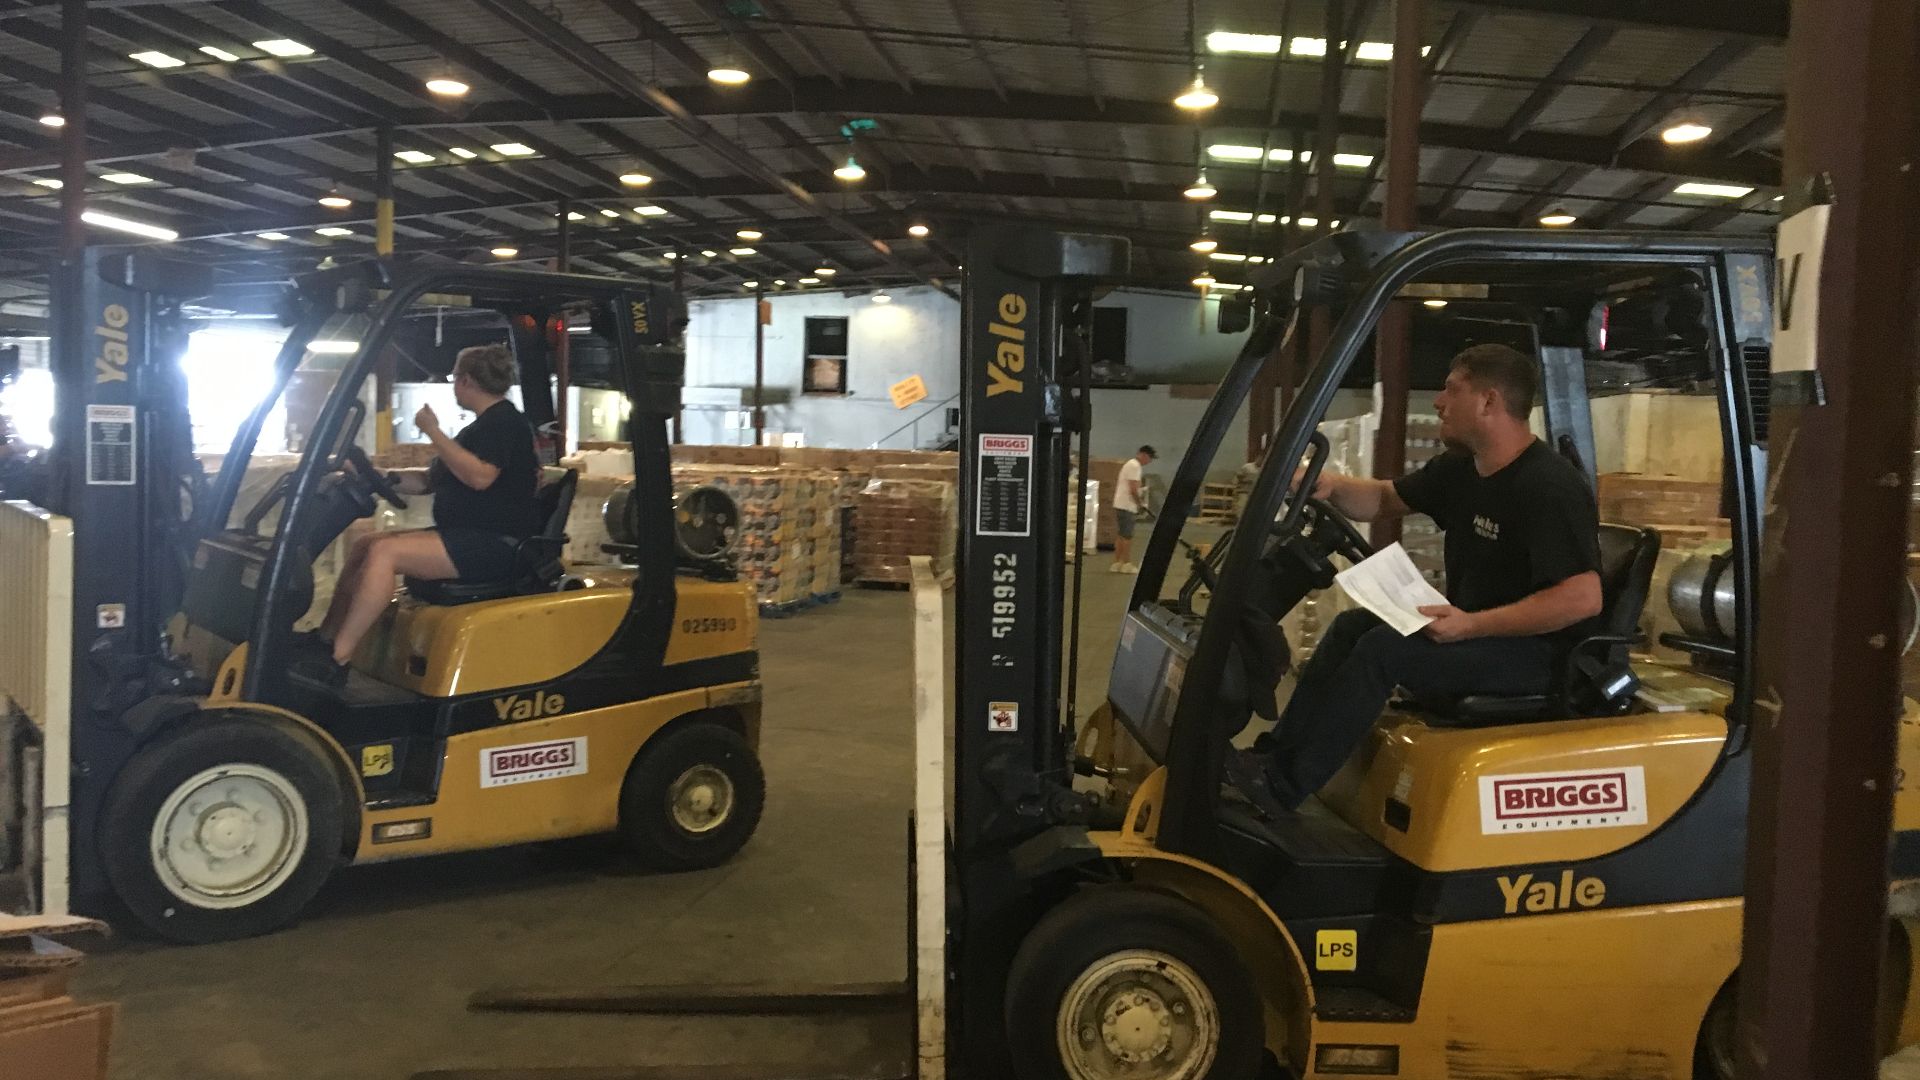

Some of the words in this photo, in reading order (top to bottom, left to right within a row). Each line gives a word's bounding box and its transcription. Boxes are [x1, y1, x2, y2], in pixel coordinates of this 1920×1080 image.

[94, 304, 129, 384] Yale
[987, 293, 1027, 397] Yale
[985, 439, 1026, 449] BRIGGS
[493, 691, 565, 721] Yale
[496, 747, 569, 770] BRIGGS
[1504, 783, 1618, 810] BRIGGS
[1502, 816, 1621, 830] EQUIPMENT
[1497, 870, 1606, 914] Yale
[1319, 943, 1353, 957] LPS
